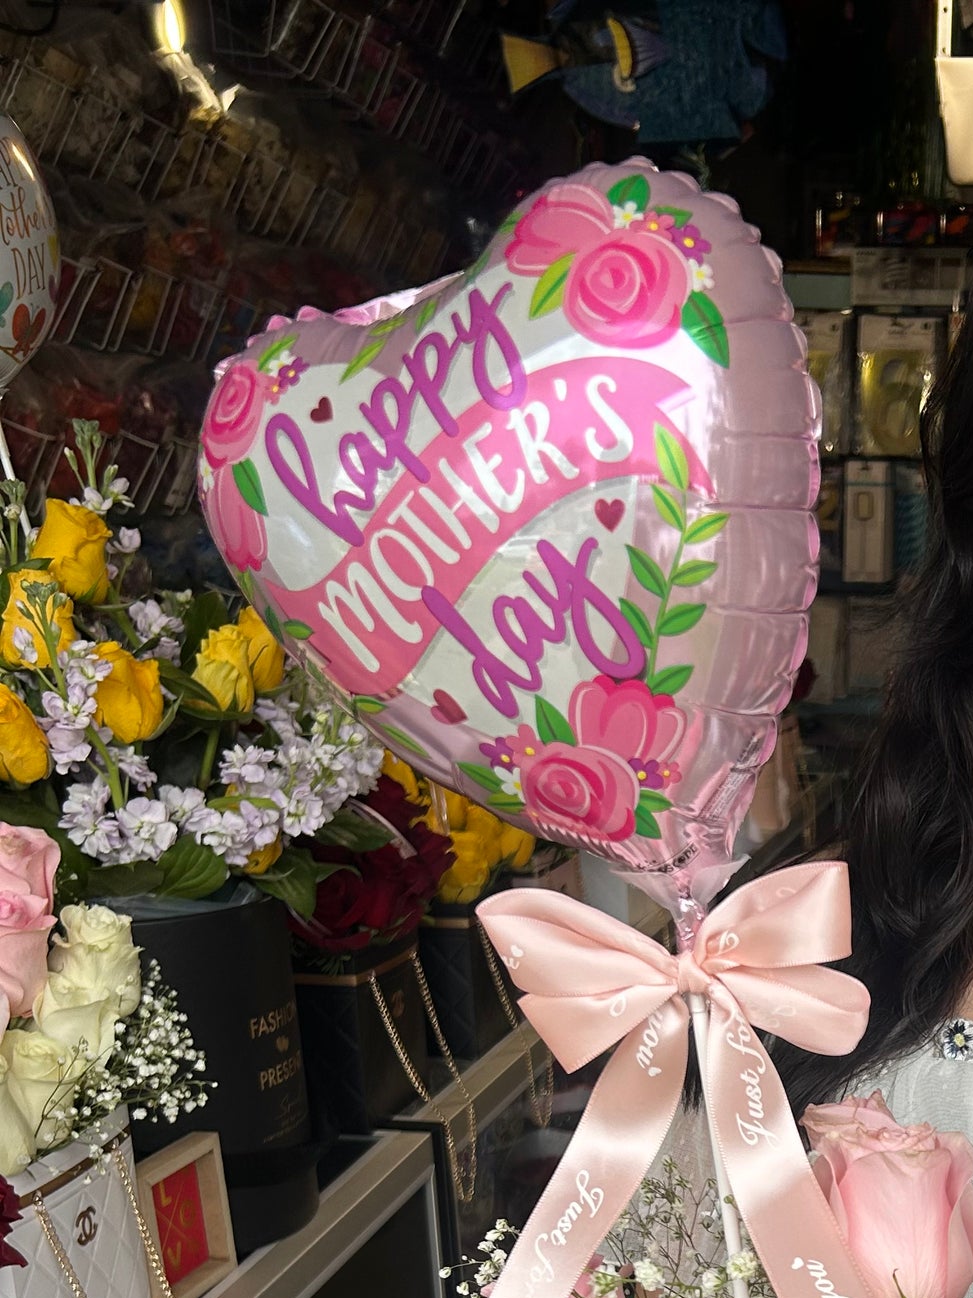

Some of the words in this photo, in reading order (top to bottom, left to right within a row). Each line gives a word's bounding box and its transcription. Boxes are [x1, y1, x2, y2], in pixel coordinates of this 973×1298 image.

[12, 243, 46, 300] DAY
[265, 281, 527, 548] happy
[318, 374, 634, 674] MOTHER'S
[420, 537, 648, 719] day
[735, 1068, 780, 1150] Just
[550, 1168, 605, 1248] Just
